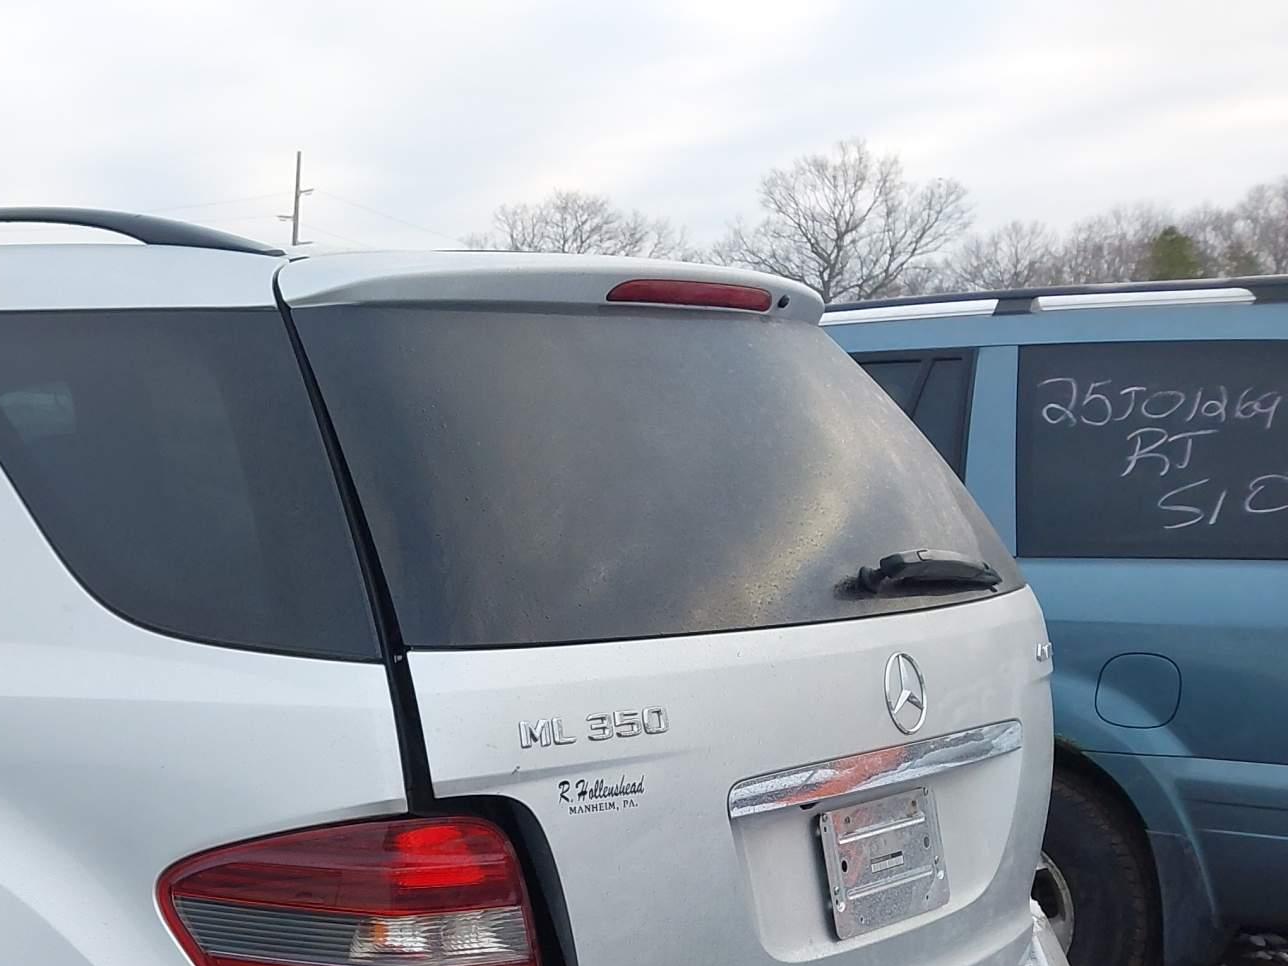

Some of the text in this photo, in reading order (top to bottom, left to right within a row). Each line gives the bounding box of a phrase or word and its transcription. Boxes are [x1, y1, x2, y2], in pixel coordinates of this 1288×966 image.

[518, 705, 670, 749] ML 350
[569, 798, 639, 815] MANHEIM, PA.
